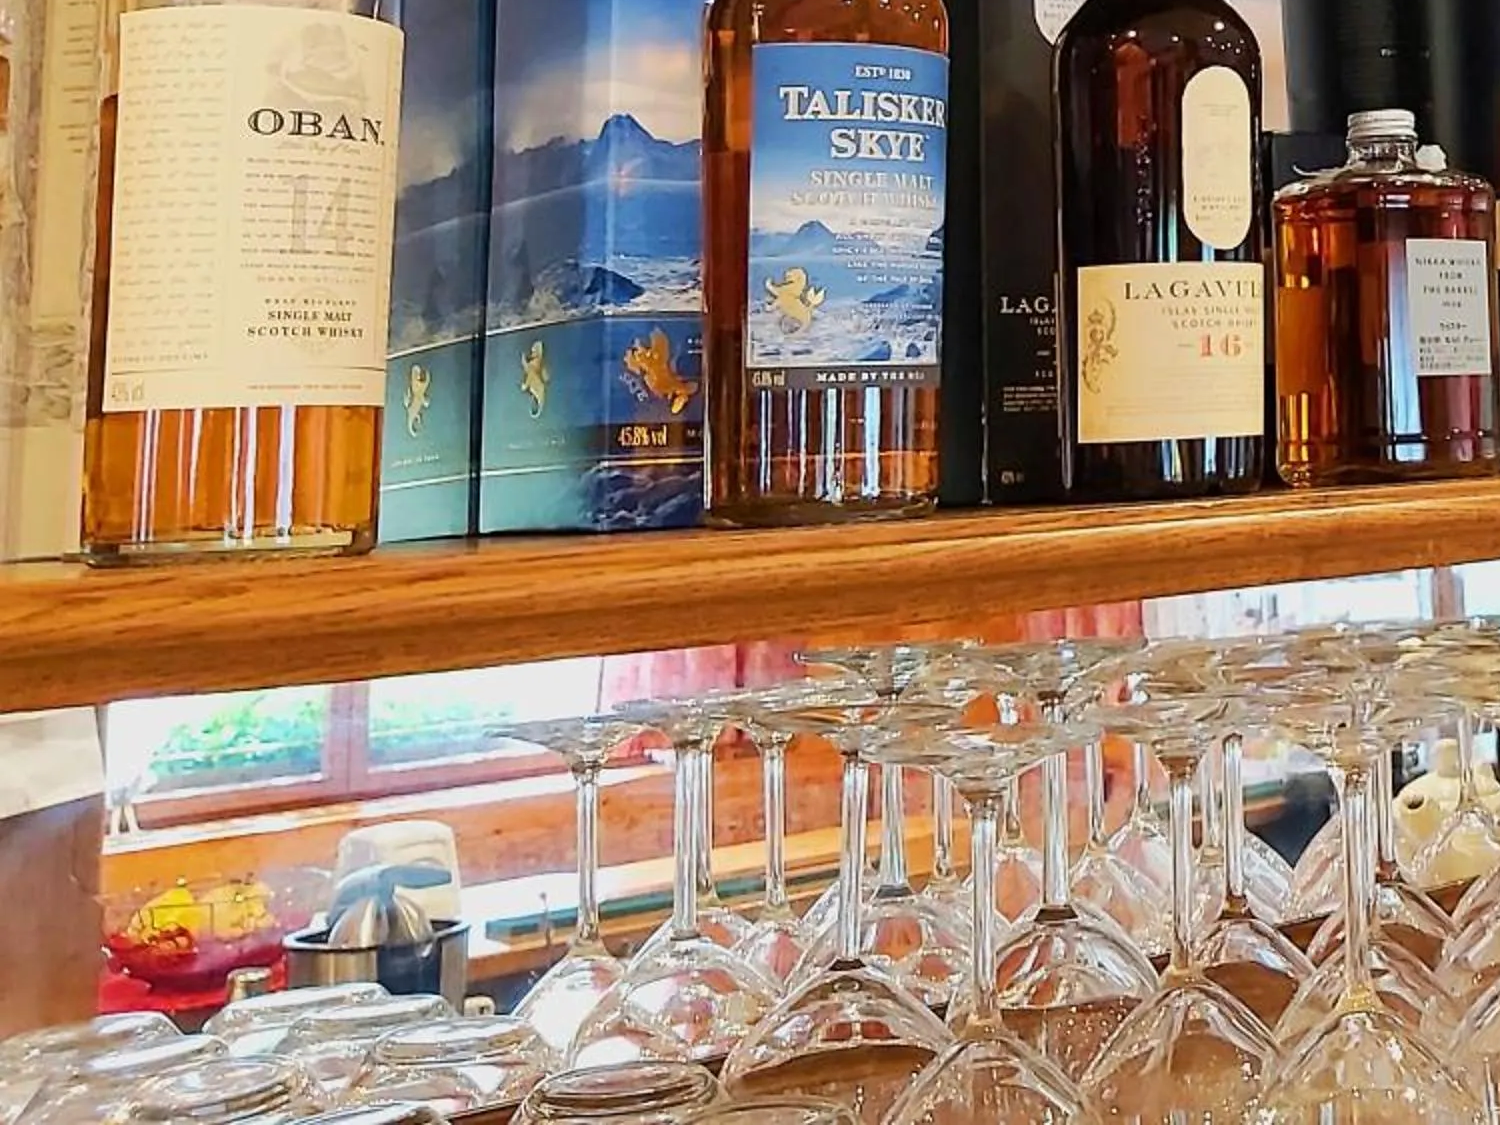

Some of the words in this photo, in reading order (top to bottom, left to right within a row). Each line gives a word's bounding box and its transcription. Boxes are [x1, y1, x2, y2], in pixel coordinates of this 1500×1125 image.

[779, 85, 945, 128] TALISKER
[830, 128, 925, 162] SKYE
[810, 169, 887, 188] SINGLE
[893, 172, 936, 191] MALT
[1000, 295, 1058, 314] LAG
[246, 326, 311, 338] SCOTCH
[1200, 333, 1243, 358] 16
[815, 371, 857, 383] MADE
[861, 371, 878, 382] BY
